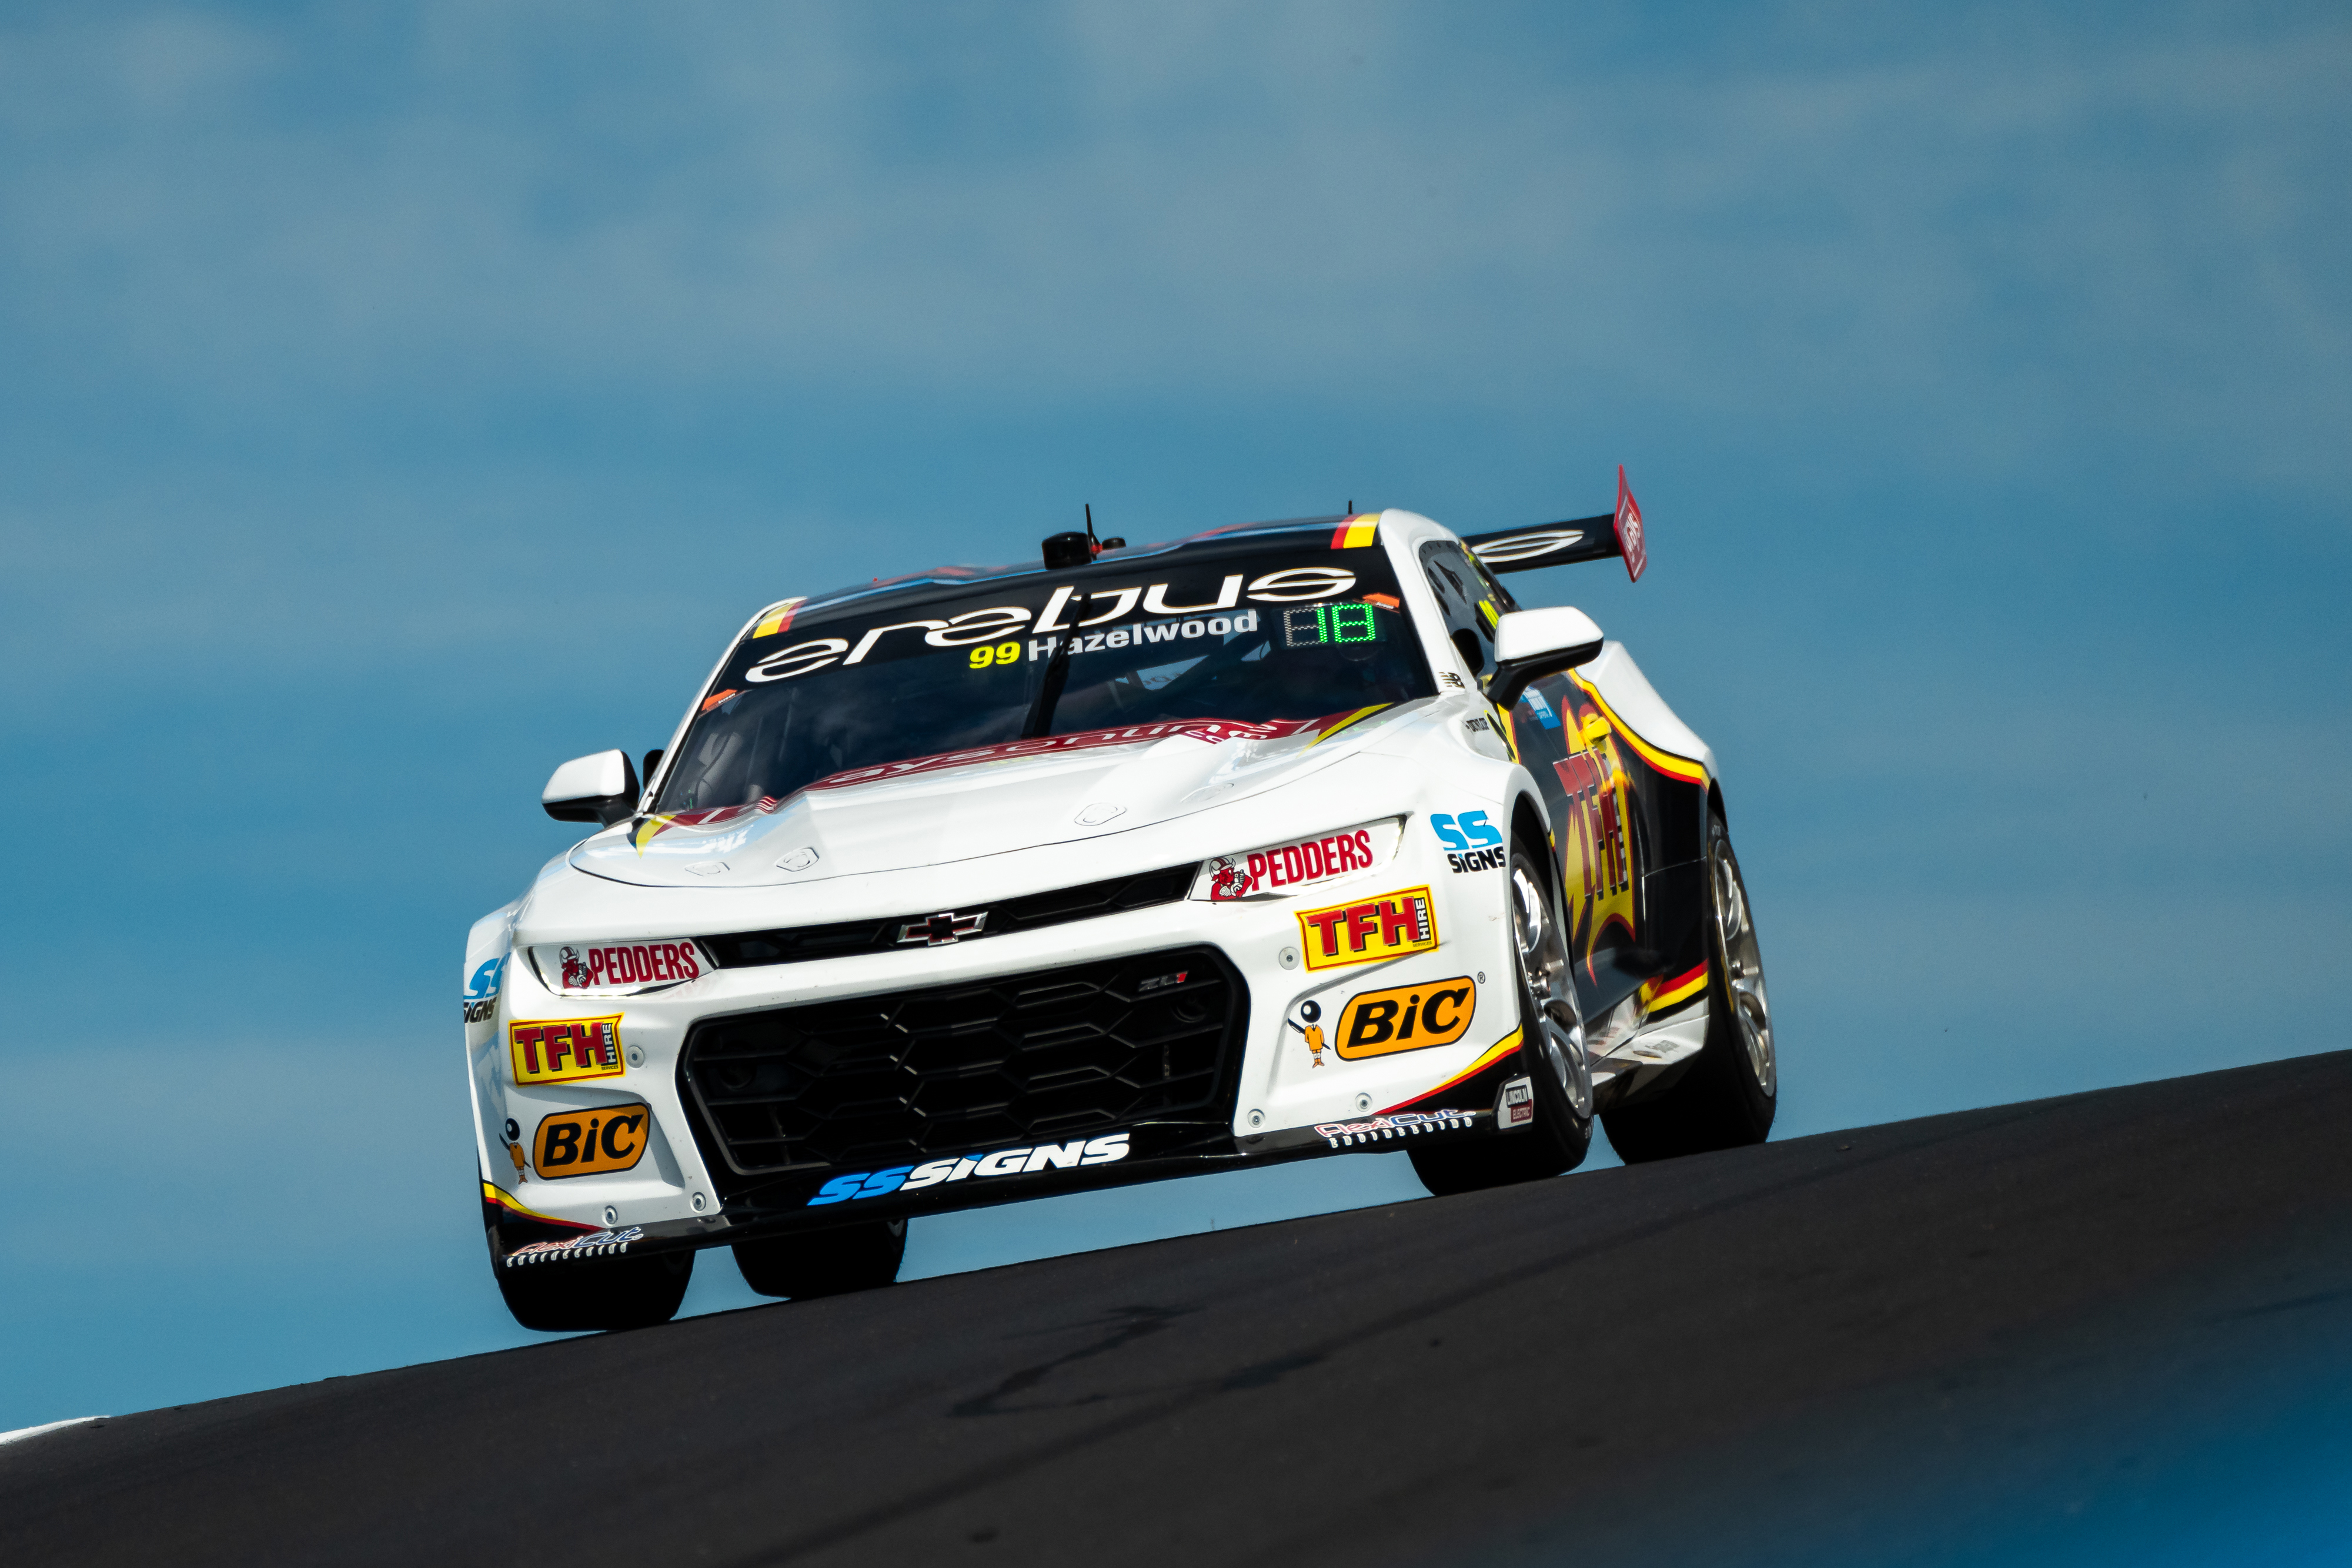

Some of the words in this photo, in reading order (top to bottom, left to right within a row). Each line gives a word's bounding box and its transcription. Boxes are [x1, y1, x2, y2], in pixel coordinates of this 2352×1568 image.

[745, 566, 1356, 683] erebus
[968, 641, 1021, 669] 99
[1028, 609, 1257, 661] Hazelwood
[1430, 810, 1503, 852] SS
[1247, 830, 1373, 891] PEDDERS
[1305, 896, 1421, 957] TFH
[1415, 897, 1431, 941] HIRE
[589, 942, 700, 986] PEDDERS
[513, 1022, 608, 1074] TFH
[602, 1023, 618, 1064] HIRE
[1506, 1086, 1528, 1106] LINCOLN
[1512, 1106, 1530, 1120] ELECTRIC
